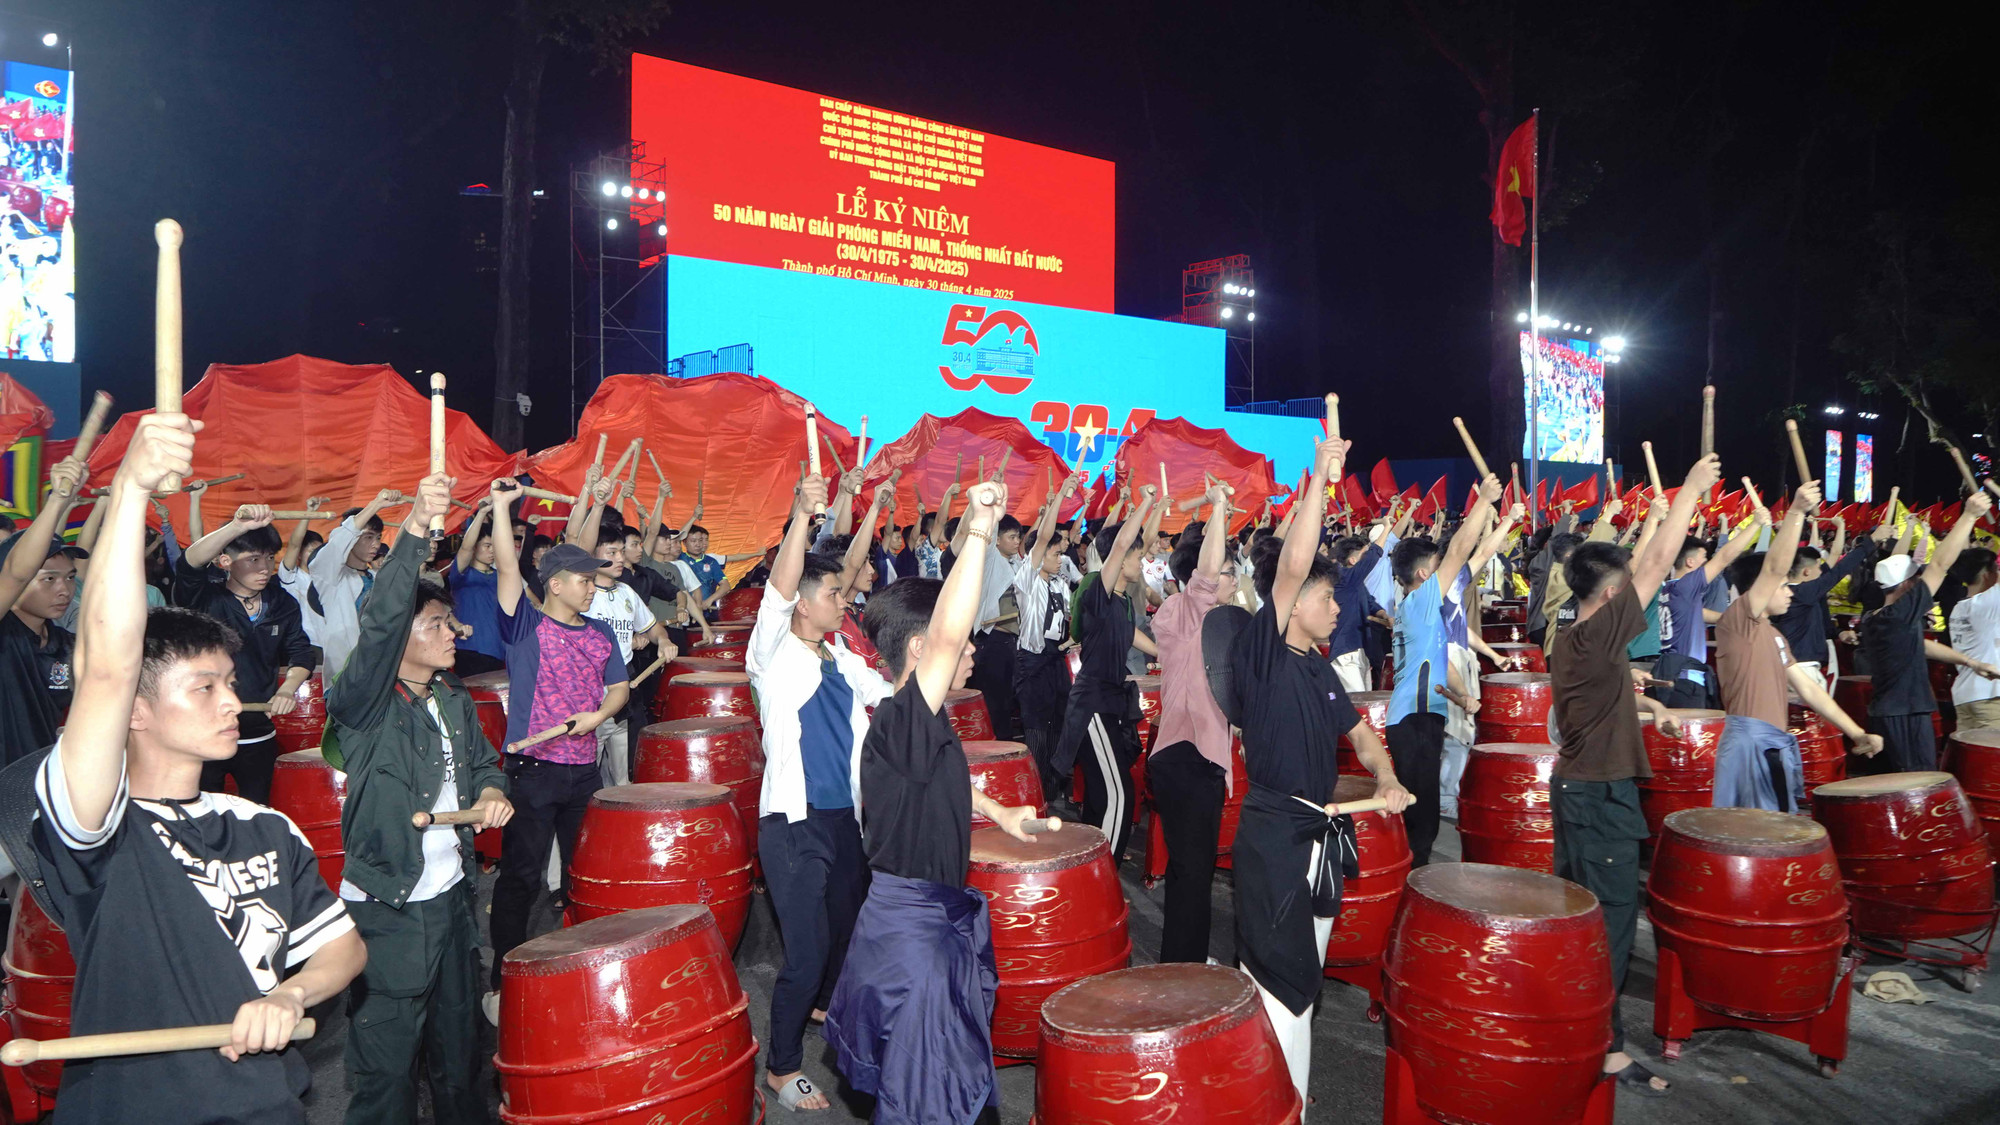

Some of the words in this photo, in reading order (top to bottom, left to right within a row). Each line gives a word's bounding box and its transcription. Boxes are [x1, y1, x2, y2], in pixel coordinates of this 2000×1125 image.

[820, 98, 834, 108] BAN
[971, 133, 984, 142] NAM
[968, 155, 981, 165] NAM
[969, 144, 982, 153] NAM
[839, 152, 853, 162] BAN
[962, 177, 976, 186] NAM
[971, 167, 984, 176] NAM
[837, 186, 867, 218] LỄ
[874, 197, 907, 224] KỶ
[912, 206, 969, 237] NIỆM
[714, 204, 731, 221] 50
[735, 206, 766, 227] NĂM
[770, 213, 805, 233] NGÀY
[808, 216, 834, 238] GIẢI
[837, 223, 878, 245] PHÓNG
[881, 229, 911, 250] MIỀN
[914, 236, 943, 257] NAM,
[946, 239, 982, 261] THỐNG
[984, 246, 1012, 265] NHẤT
[1014, 249, 1034, 268] ĐẤT
[1036, 255, 1063, 273] NƯỚC
[837, 243, 900, 267] (30/4/1975
[910, 254, 969, 278] 30/4/2025)
[782, 259, 813, 274] Thành
[816, 264, 837, 278] phố
[836, 267, 852, 280] Hồ
[854, 269, 872, 282] Chí
[873, 272, 901, 286] Minh,
[902, 278, 925, 290] ngày
[927, 279, 938, 291] 30
[940, 281, 964, 295] tháng
[966, 285, 972, 295] 4
[974, 287, 991, 298] năm
[993, 288, 1014, 301] 2025
[953, 352, 971, 363] 30.4
[795, 1078, 813, 1095] G
